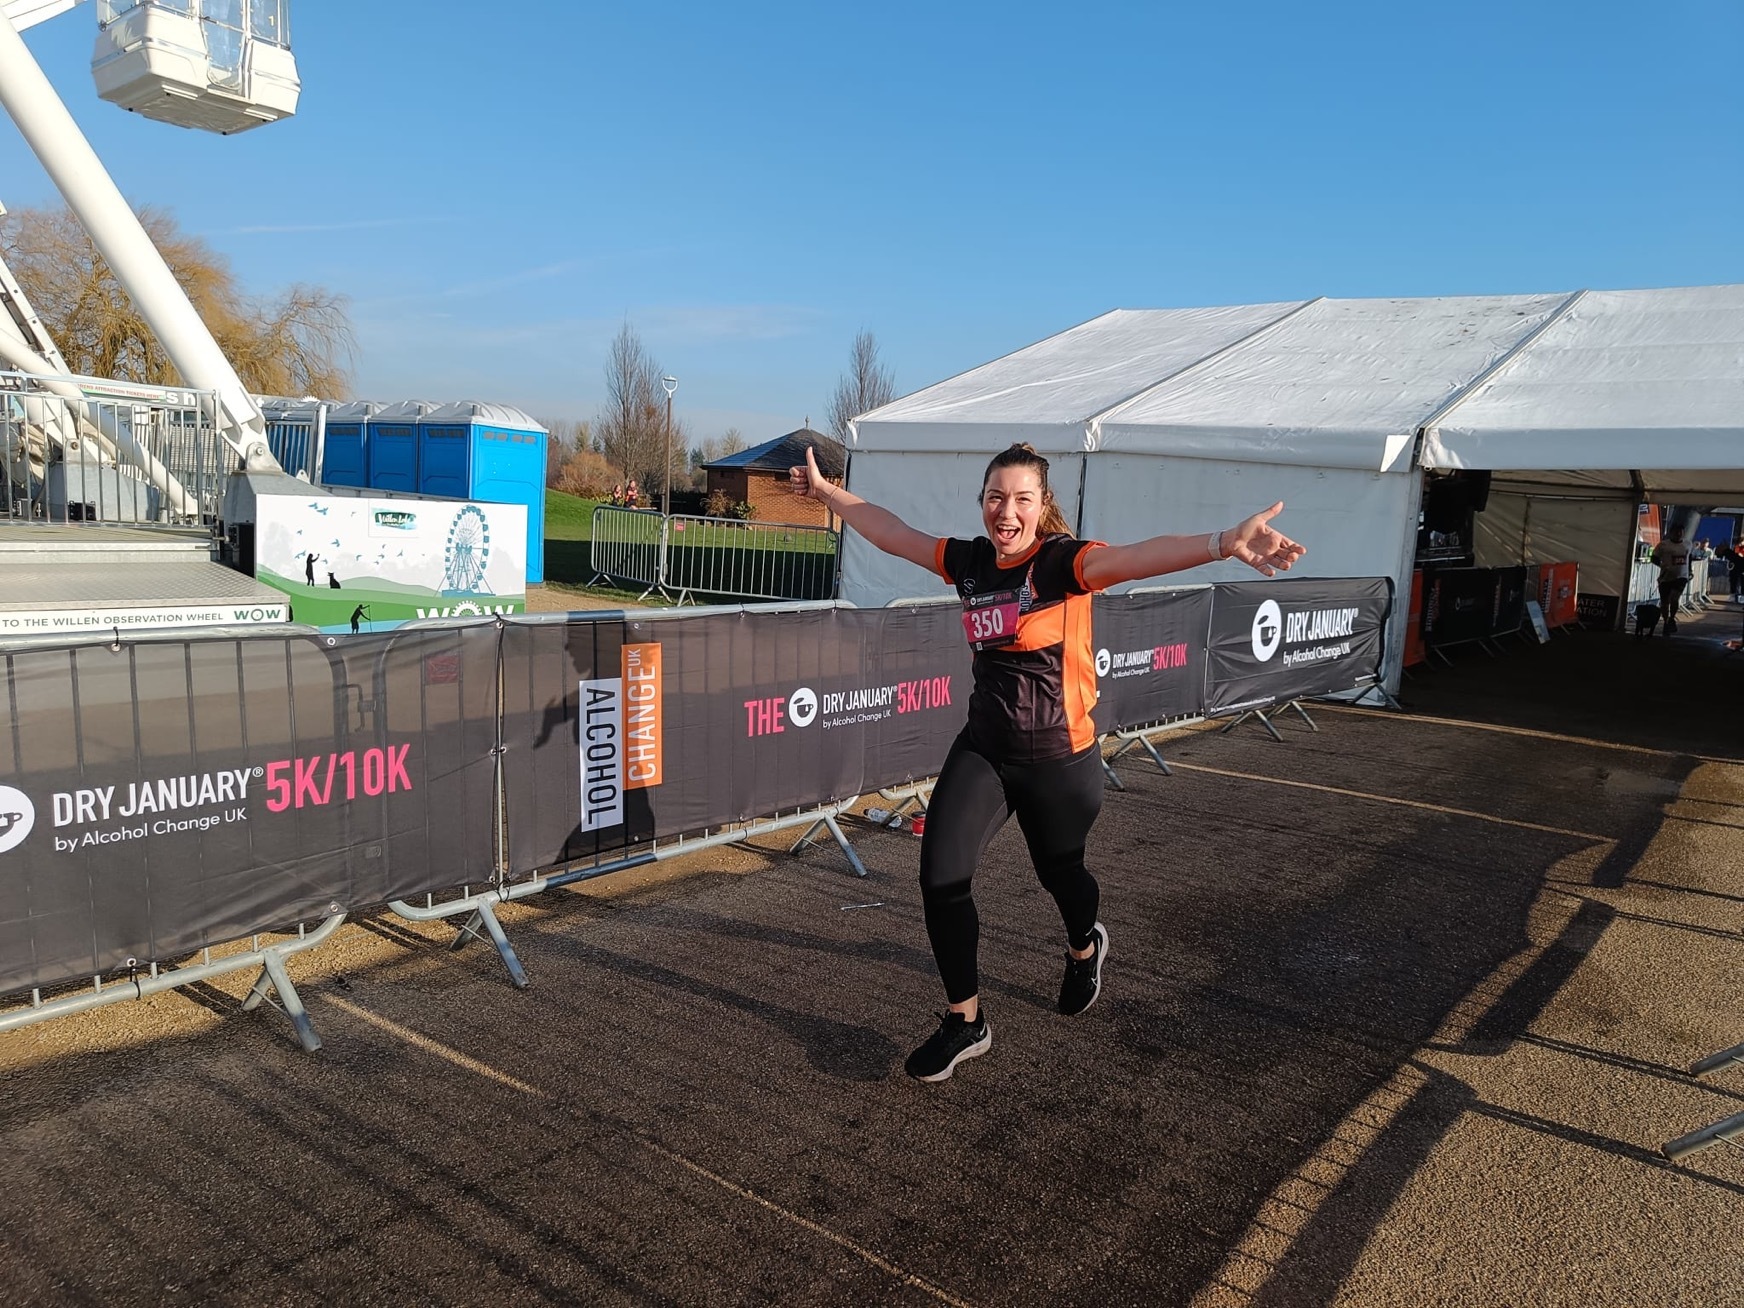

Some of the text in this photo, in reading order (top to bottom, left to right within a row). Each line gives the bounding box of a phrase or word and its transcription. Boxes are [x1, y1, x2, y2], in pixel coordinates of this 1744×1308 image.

[53, 617, 100, 626] WILLEN
[104, 615, 183, 624] OBSERVATION
[234, 609, 280, 621] WOW
[1577, 607, 1608, 617] ATION
[1578, 598, 1605, 607] ATER
[971, 608, 1003, 639] 350
[1286, 611, 1310, 643] DRY
[1113, 653, 1126, 668] DRY
[1153, 643, 1187, 670] 5K/10K
[1283, 642, 1350, 667] by Alcohol Change UK
[628, 648, 656, 782] CHANGE UK
[744, 676, 951, 737] THE DRY JANUARY® 5K/10K
[822, 709, 891, 730] by Alcohol Change UK
[586, 688, 617, 825] ALCOHOL
[53, 744, 412, 827] DRY JANUARY® 5K/10K
[55, 808, 247, 853] by Alcohol Change UK
